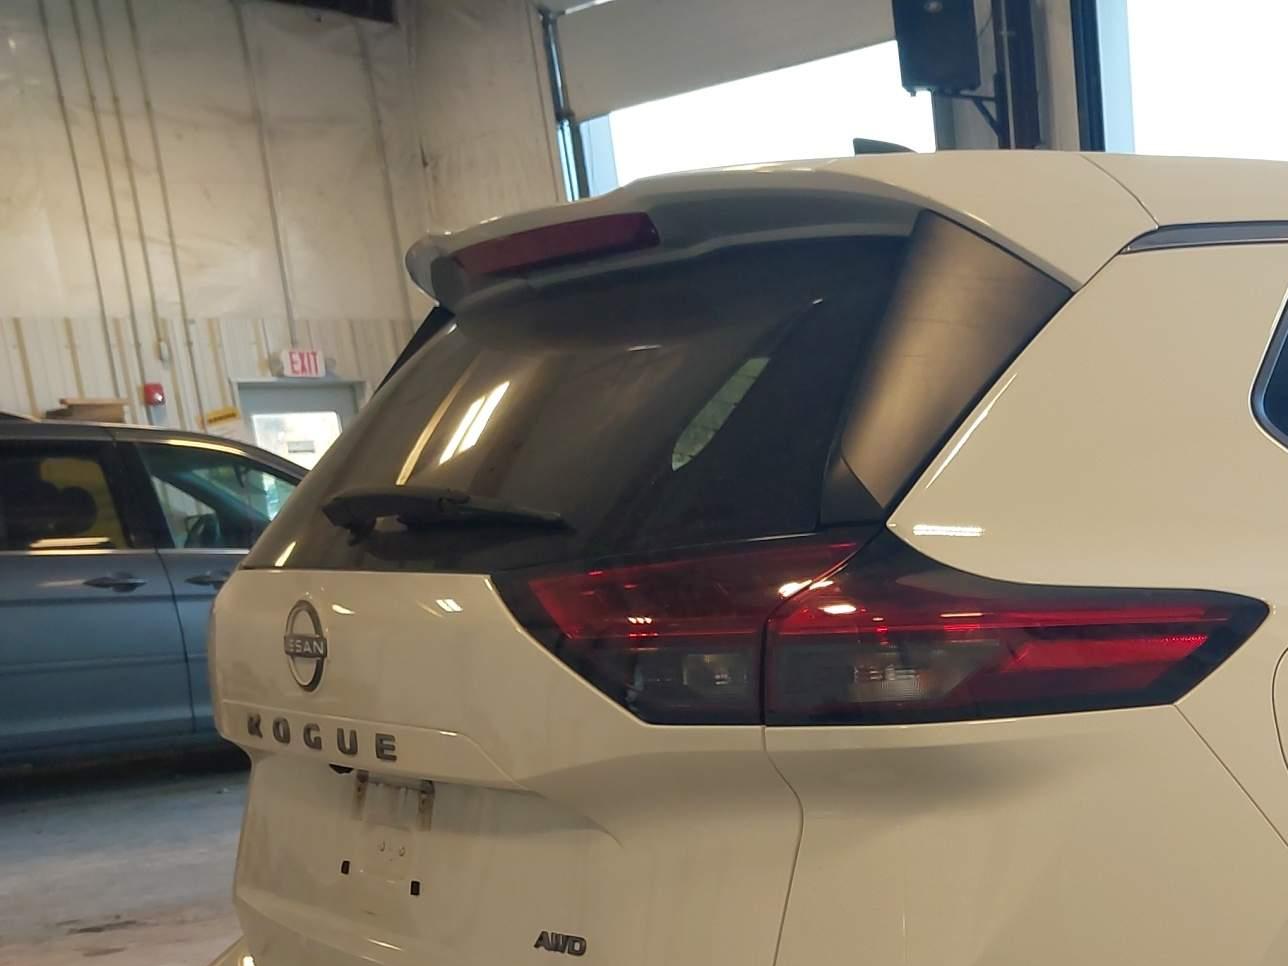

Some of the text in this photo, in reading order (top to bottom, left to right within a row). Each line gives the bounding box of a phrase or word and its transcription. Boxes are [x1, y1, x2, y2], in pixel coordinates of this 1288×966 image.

[289, 351, 318, 375] EXIT
[247, 712, 398, 762] ROGUE
[534, 930, 587, 957] AWD
